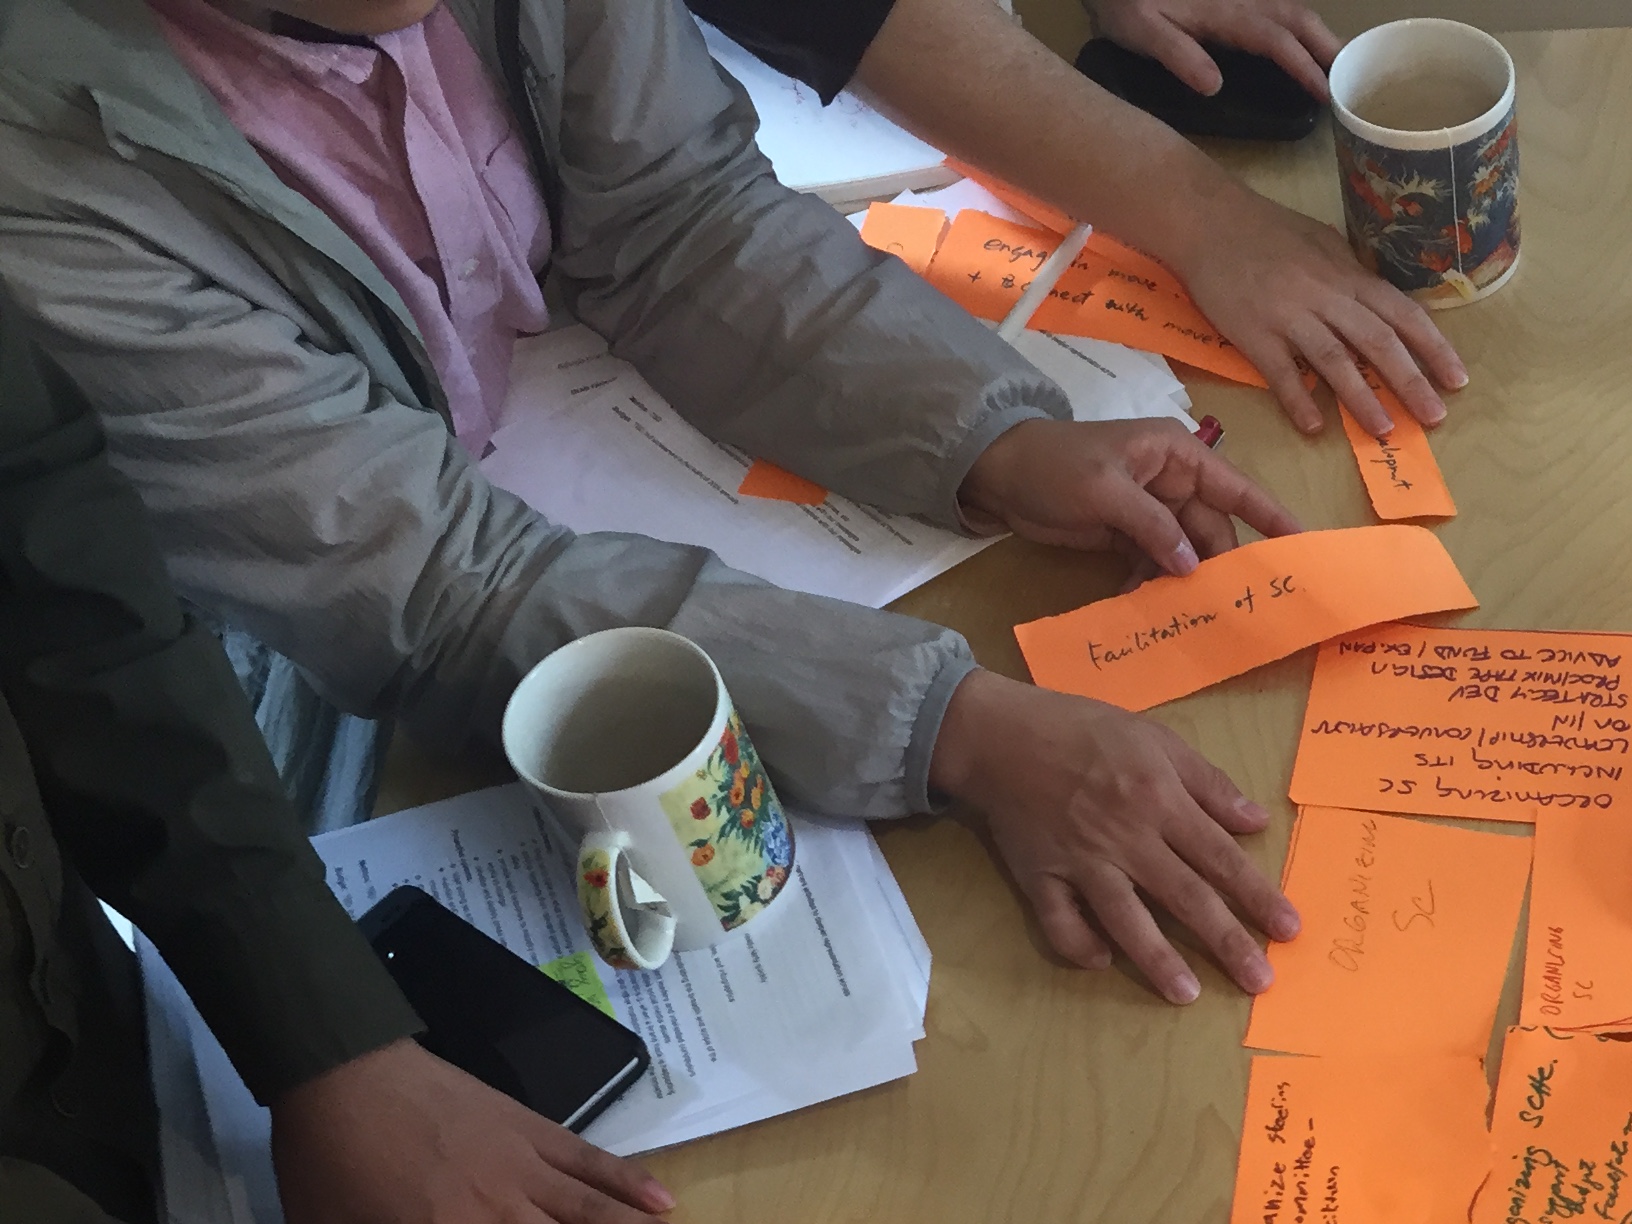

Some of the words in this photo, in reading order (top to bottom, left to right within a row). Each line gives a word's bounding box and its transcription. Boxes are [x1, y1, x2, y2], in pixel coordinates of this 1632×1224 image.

[1089, 611, 1219, 671] Facilitation
[1235, 586, 1255, 614] of
[1434, 645, 1489, 661] FUND
[1501, 649, 1528, 662] TO
[1537, 649, 1621, 668] ADVICE
[1448, 685, 1499, 702] DEV
[1414, 753, 1455, 768] ITS
[1378, 778, 1417, 795] SC
[1573, 980, 1593, 1000] SC
